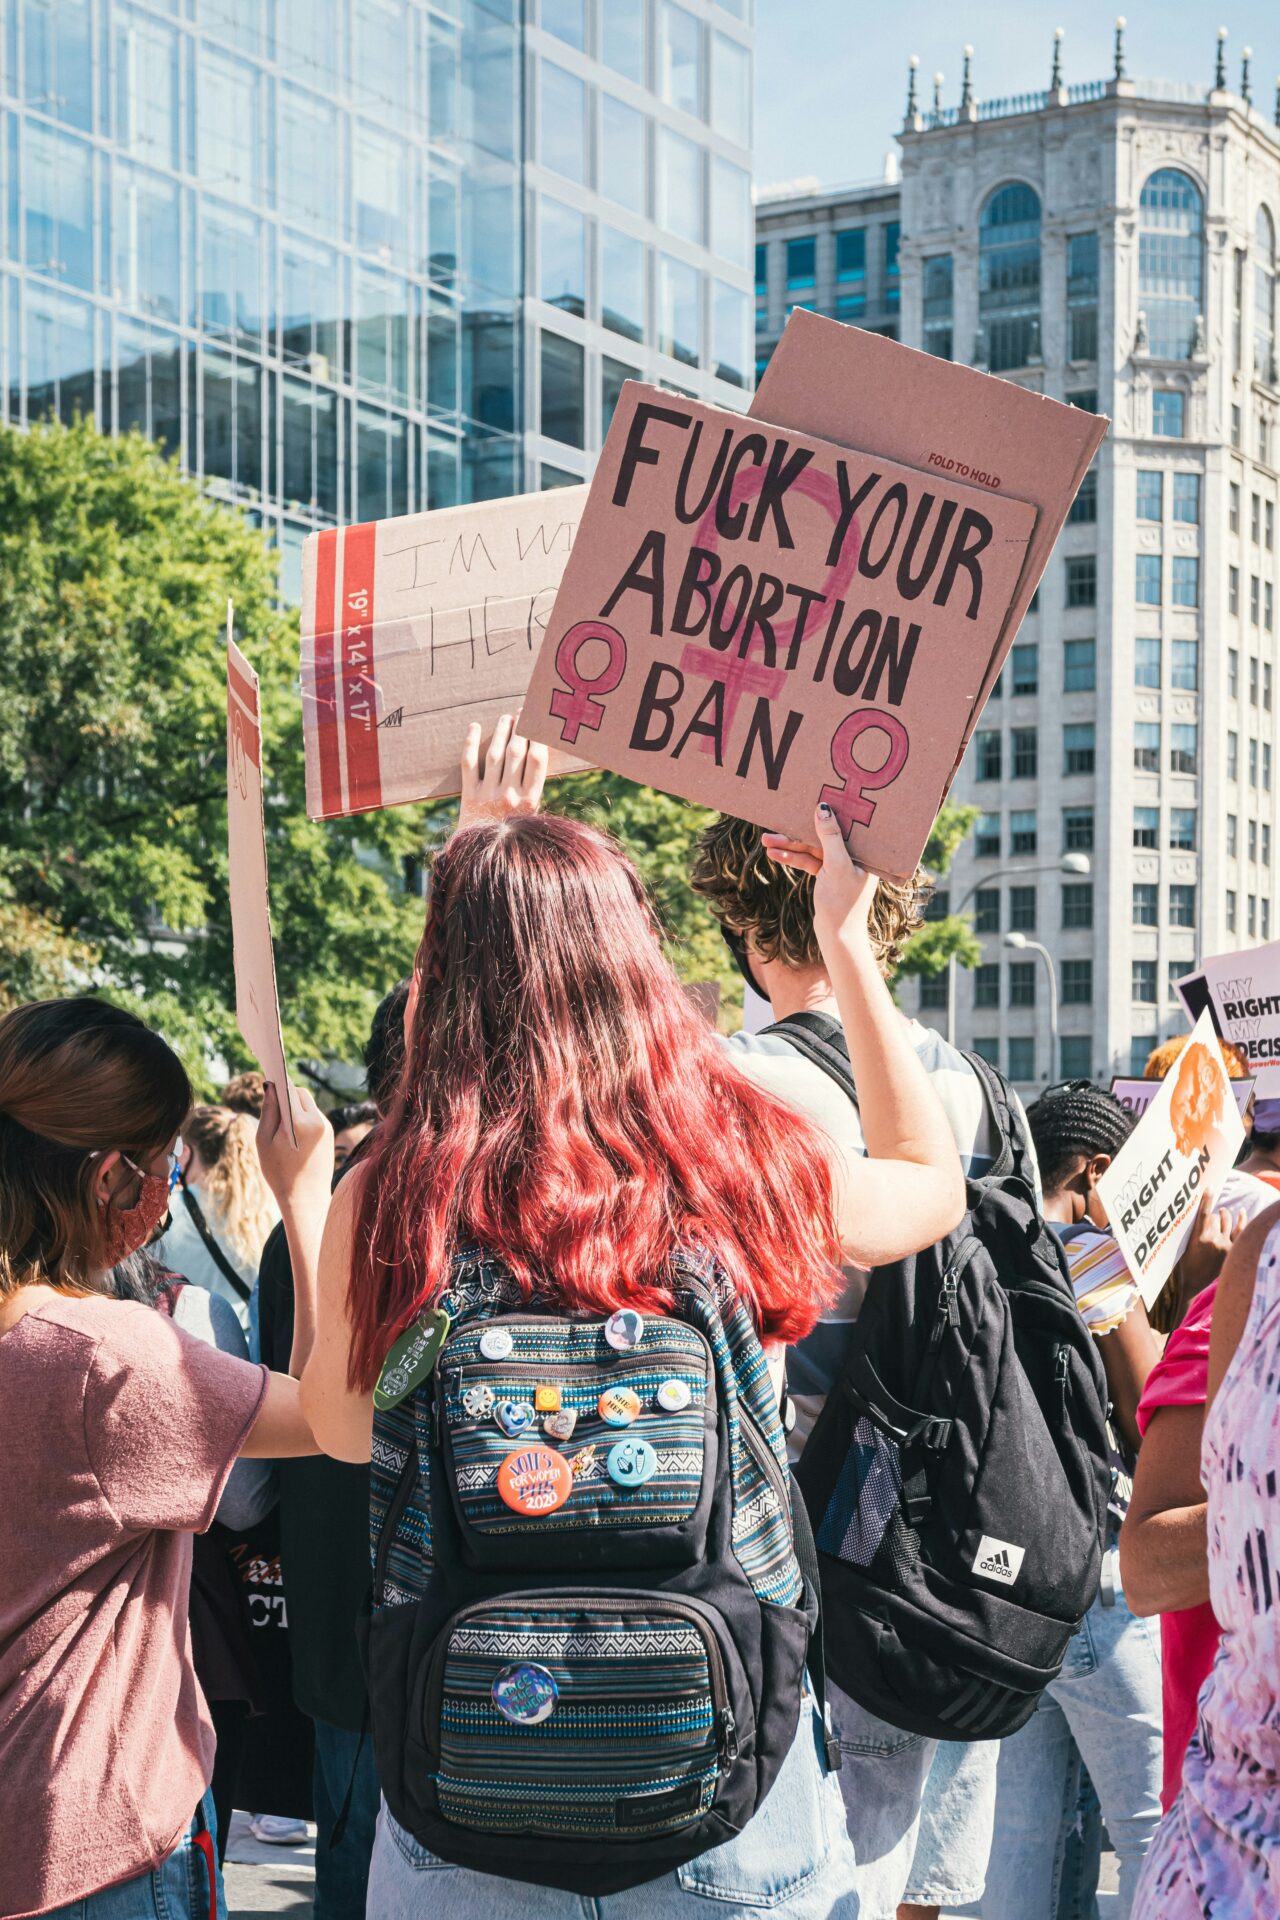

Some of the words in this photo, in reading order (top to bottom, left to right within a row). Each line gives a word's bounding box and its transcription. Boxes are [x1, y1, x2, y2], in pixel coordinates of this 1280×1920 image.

[928, 453, 954, 470] FOLD
[956, 463, 969, 476] TO
[970, 468, 1000, 488] HOLD
[612, 403, 813, 550] FUCK
[827, 460, 994, 619] YOUR
[383, 532, 497, 592] I'M
[347, 588, 368, 617] 19"
[347, 625, 361, 636] x
[599, 531, 922, 706] ABORTION
[347, 641, 368, 674] 14"
[349, 683, 362, 695] x
[349, 701, 371, 731] 17"
[629, 662, 804, 790] BAN
[1216, 977, 1252, 1001] MY
[1228, 1018, 1261, 1041] MY
[1112, 1161, 1144, 1218] MY
[1120, 1149, 1173, 1234] RIGHT
[1134, 1144, 1210, 1268] DECISION
[398, 1354, 418, 1373] 142
[606, 1400, 624, 1416] HER
[613, 1394, 632, 1410] SHE/
[509, 1474, 529, 1489] FOR
[528, 1468, 561, 1483] WOMEN
[525, 1491, 558, 1509] 2020
[980, 1561, 1013, 1577] adidas
